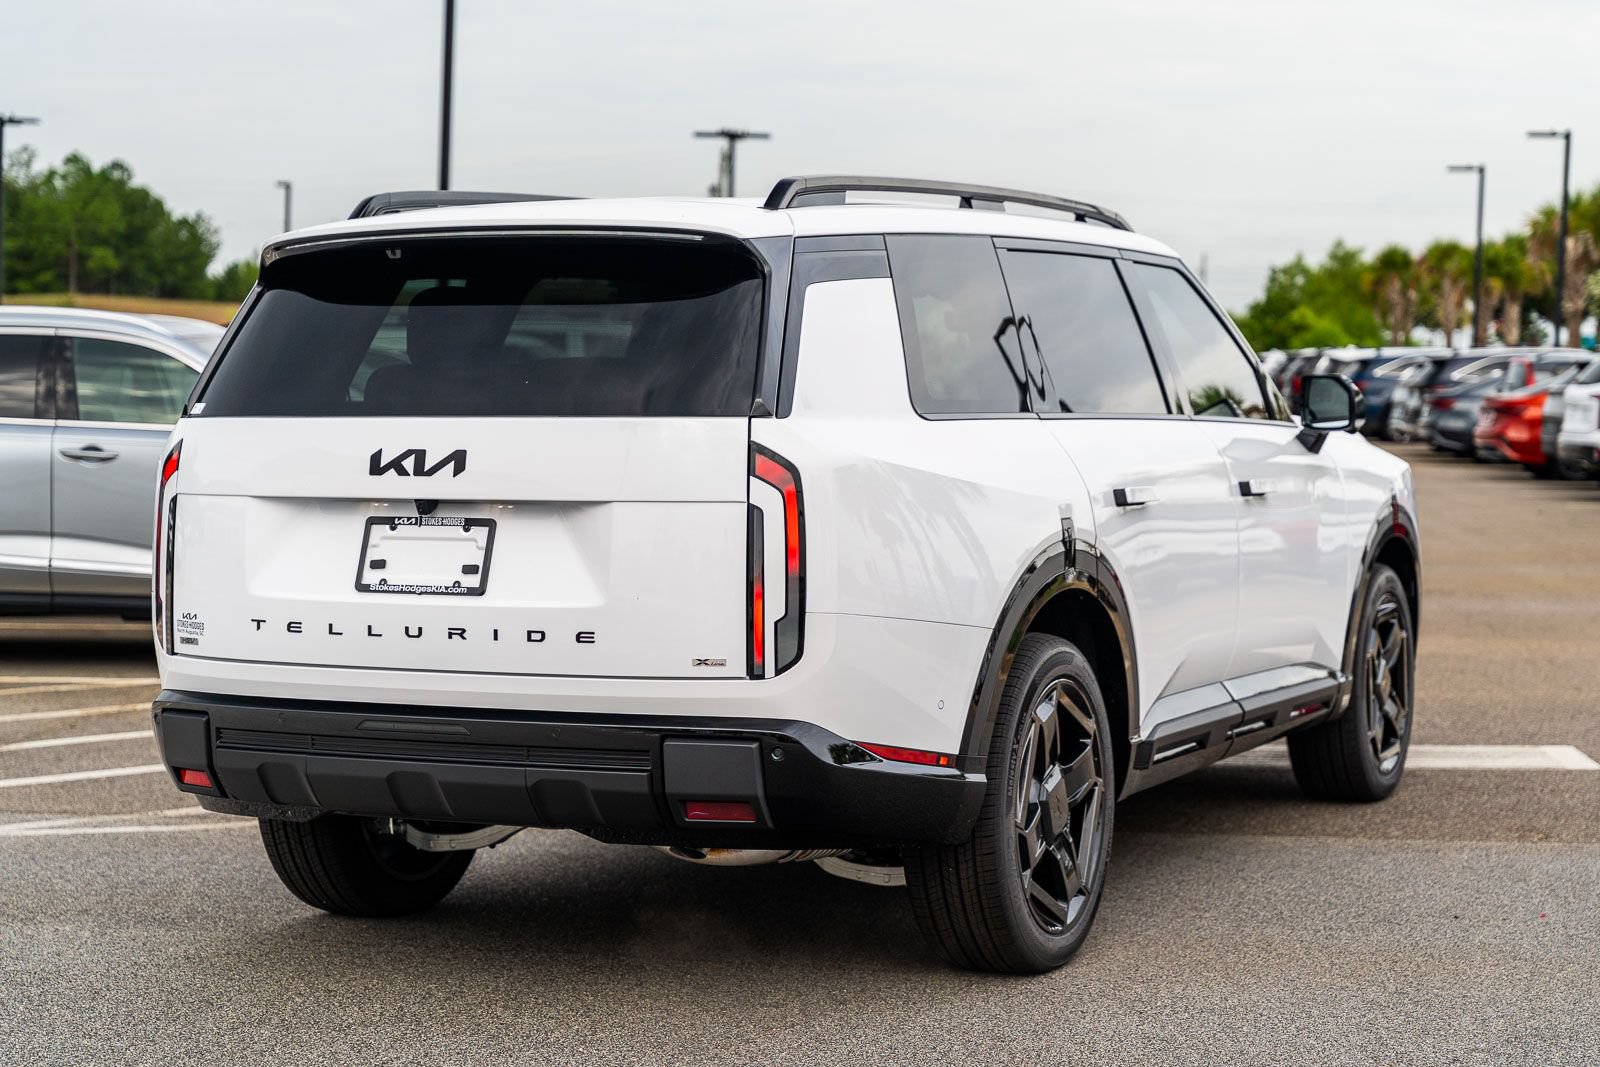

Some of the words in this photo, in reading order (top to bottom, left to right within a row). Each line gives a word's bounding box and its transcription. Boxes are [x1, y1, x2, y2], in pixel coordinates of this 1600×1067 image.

[369, 448, 467, 478] KIA
[394, 517, 416, 525] KIA
[369, 583, 468, 594] StokesHodgesKIA.com
[182, 612, 197, 620] KIA
[251, 618, 596, 644] TELLURIDE
